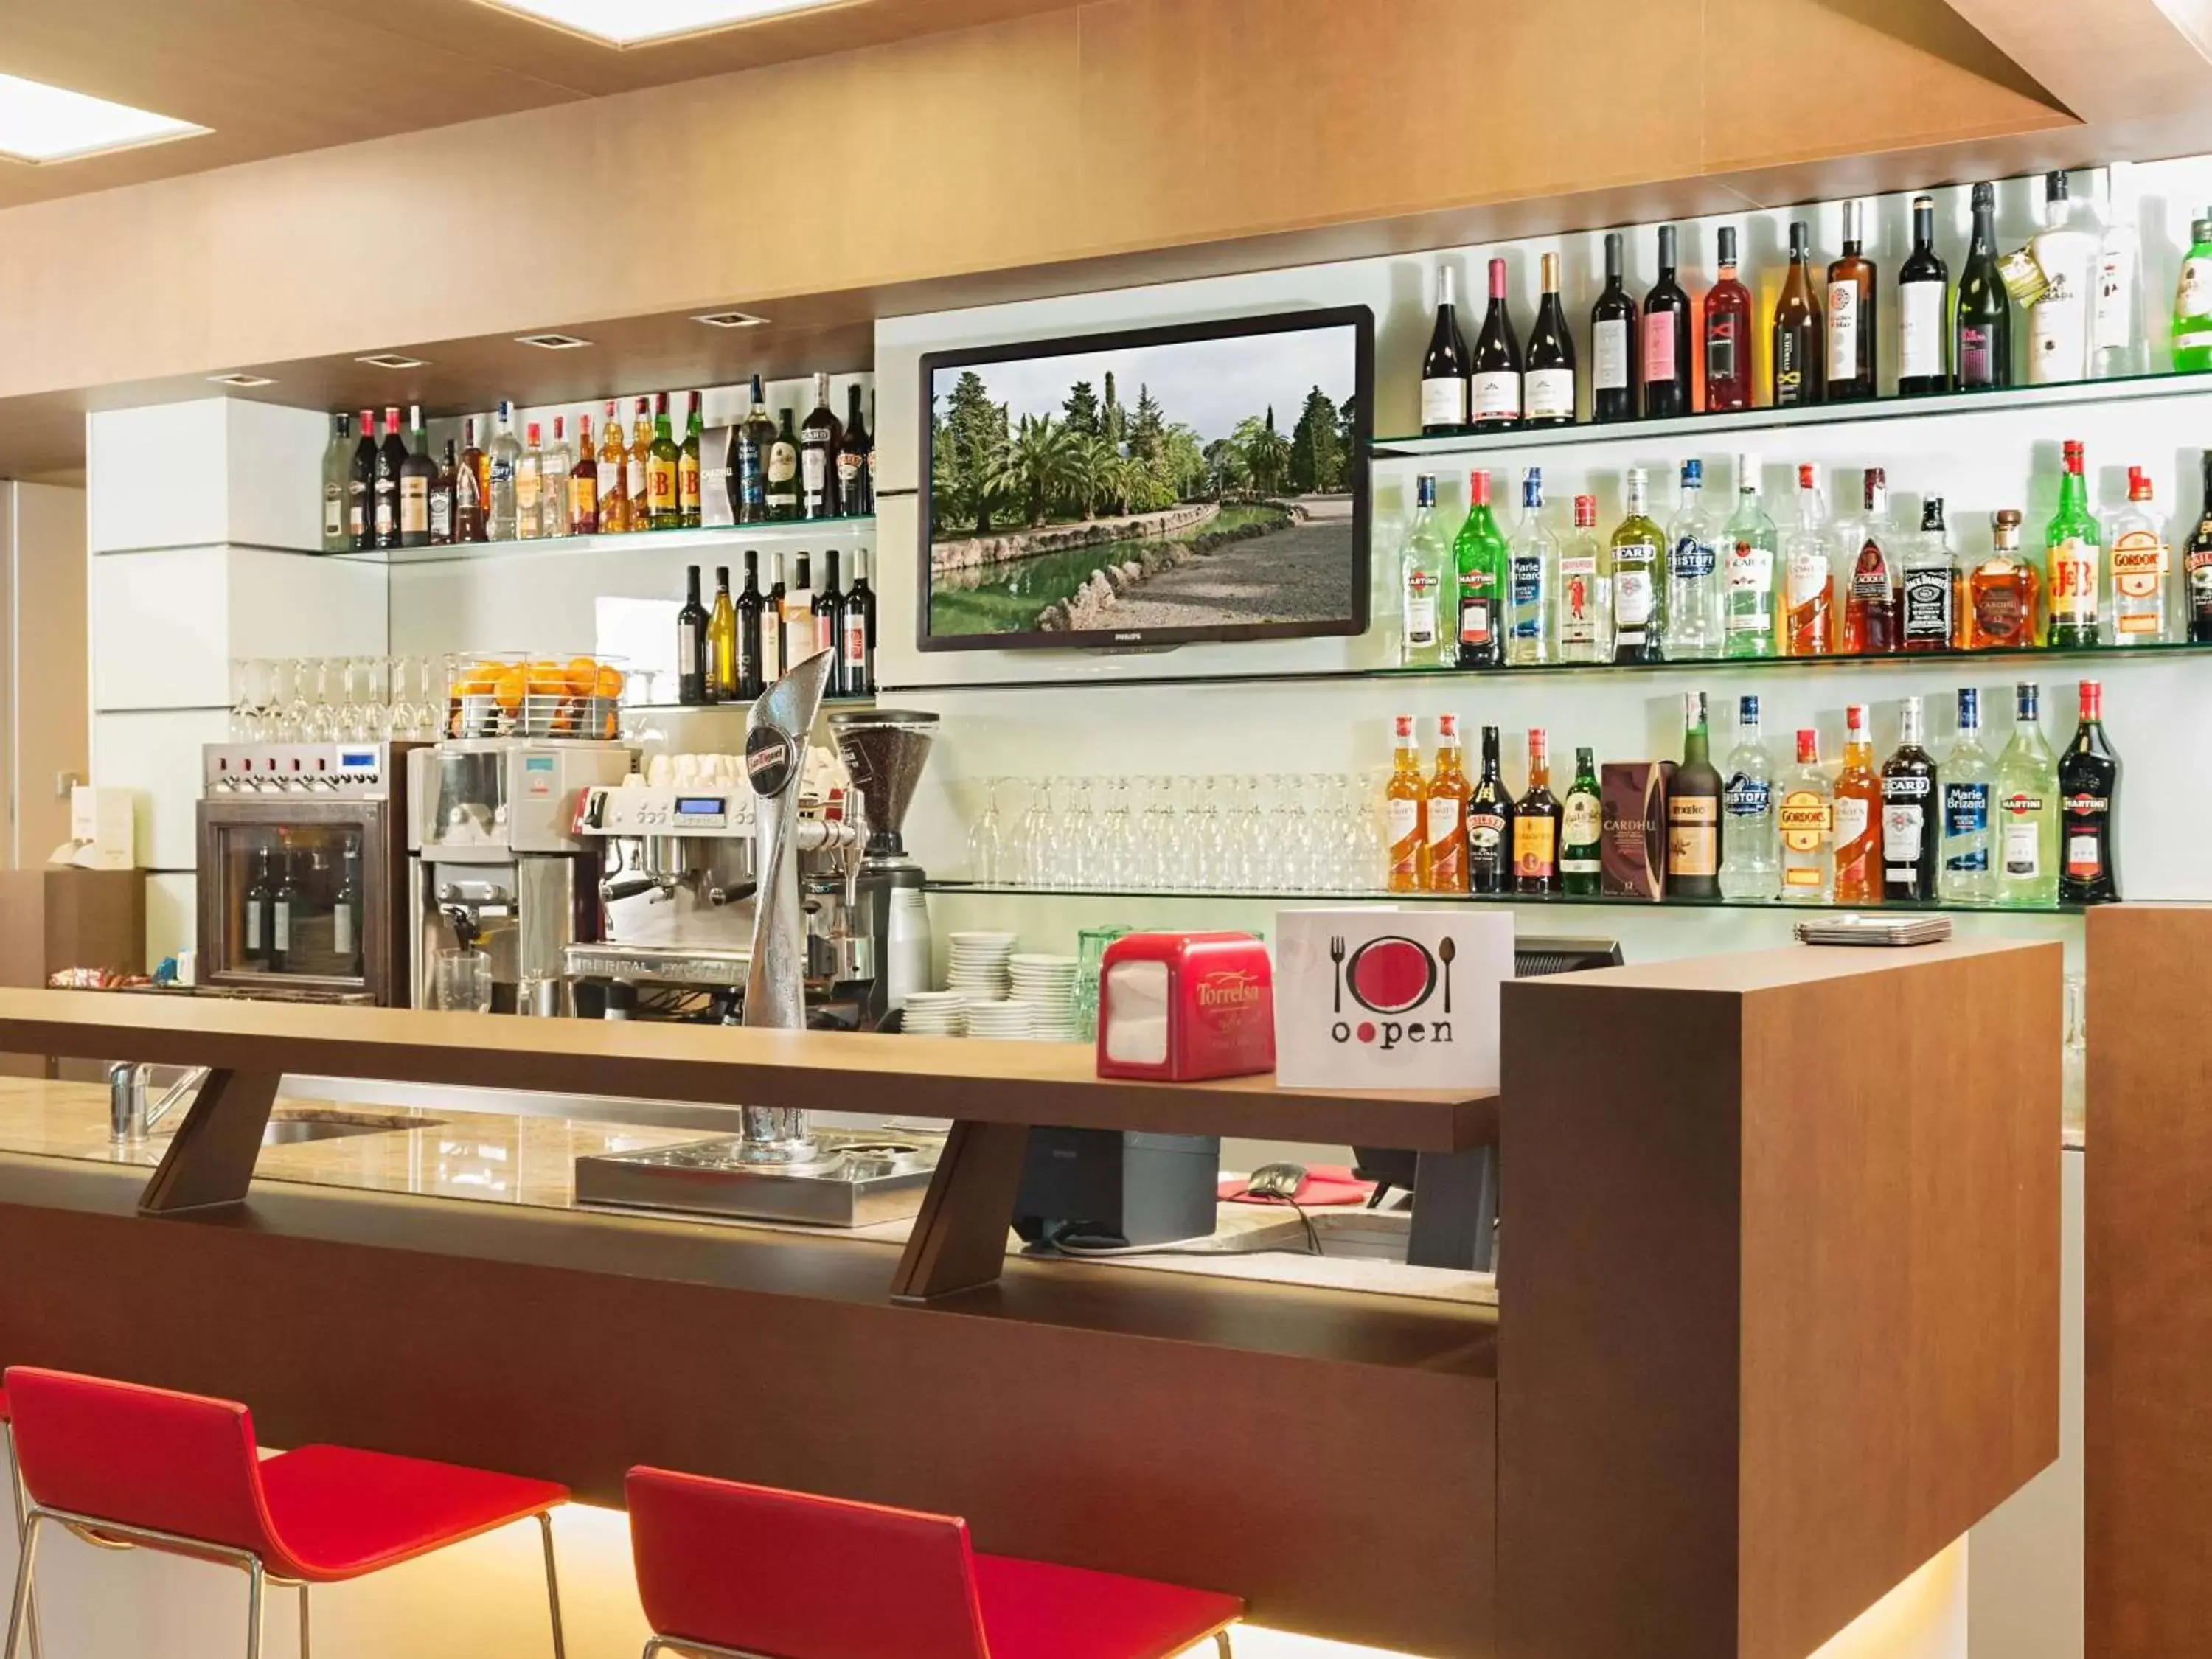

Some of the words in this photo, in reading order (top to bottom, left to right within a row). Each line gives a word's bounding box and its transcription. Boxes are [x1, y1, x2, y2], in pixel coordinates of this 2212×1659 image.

[1951, 789, 1983, 800] Marie
[1947, 798, 1986, 809] Brizard
[2002, 800, 2040, 808] MARTINI
[2066, 800, 2104, 808] MARTINI
